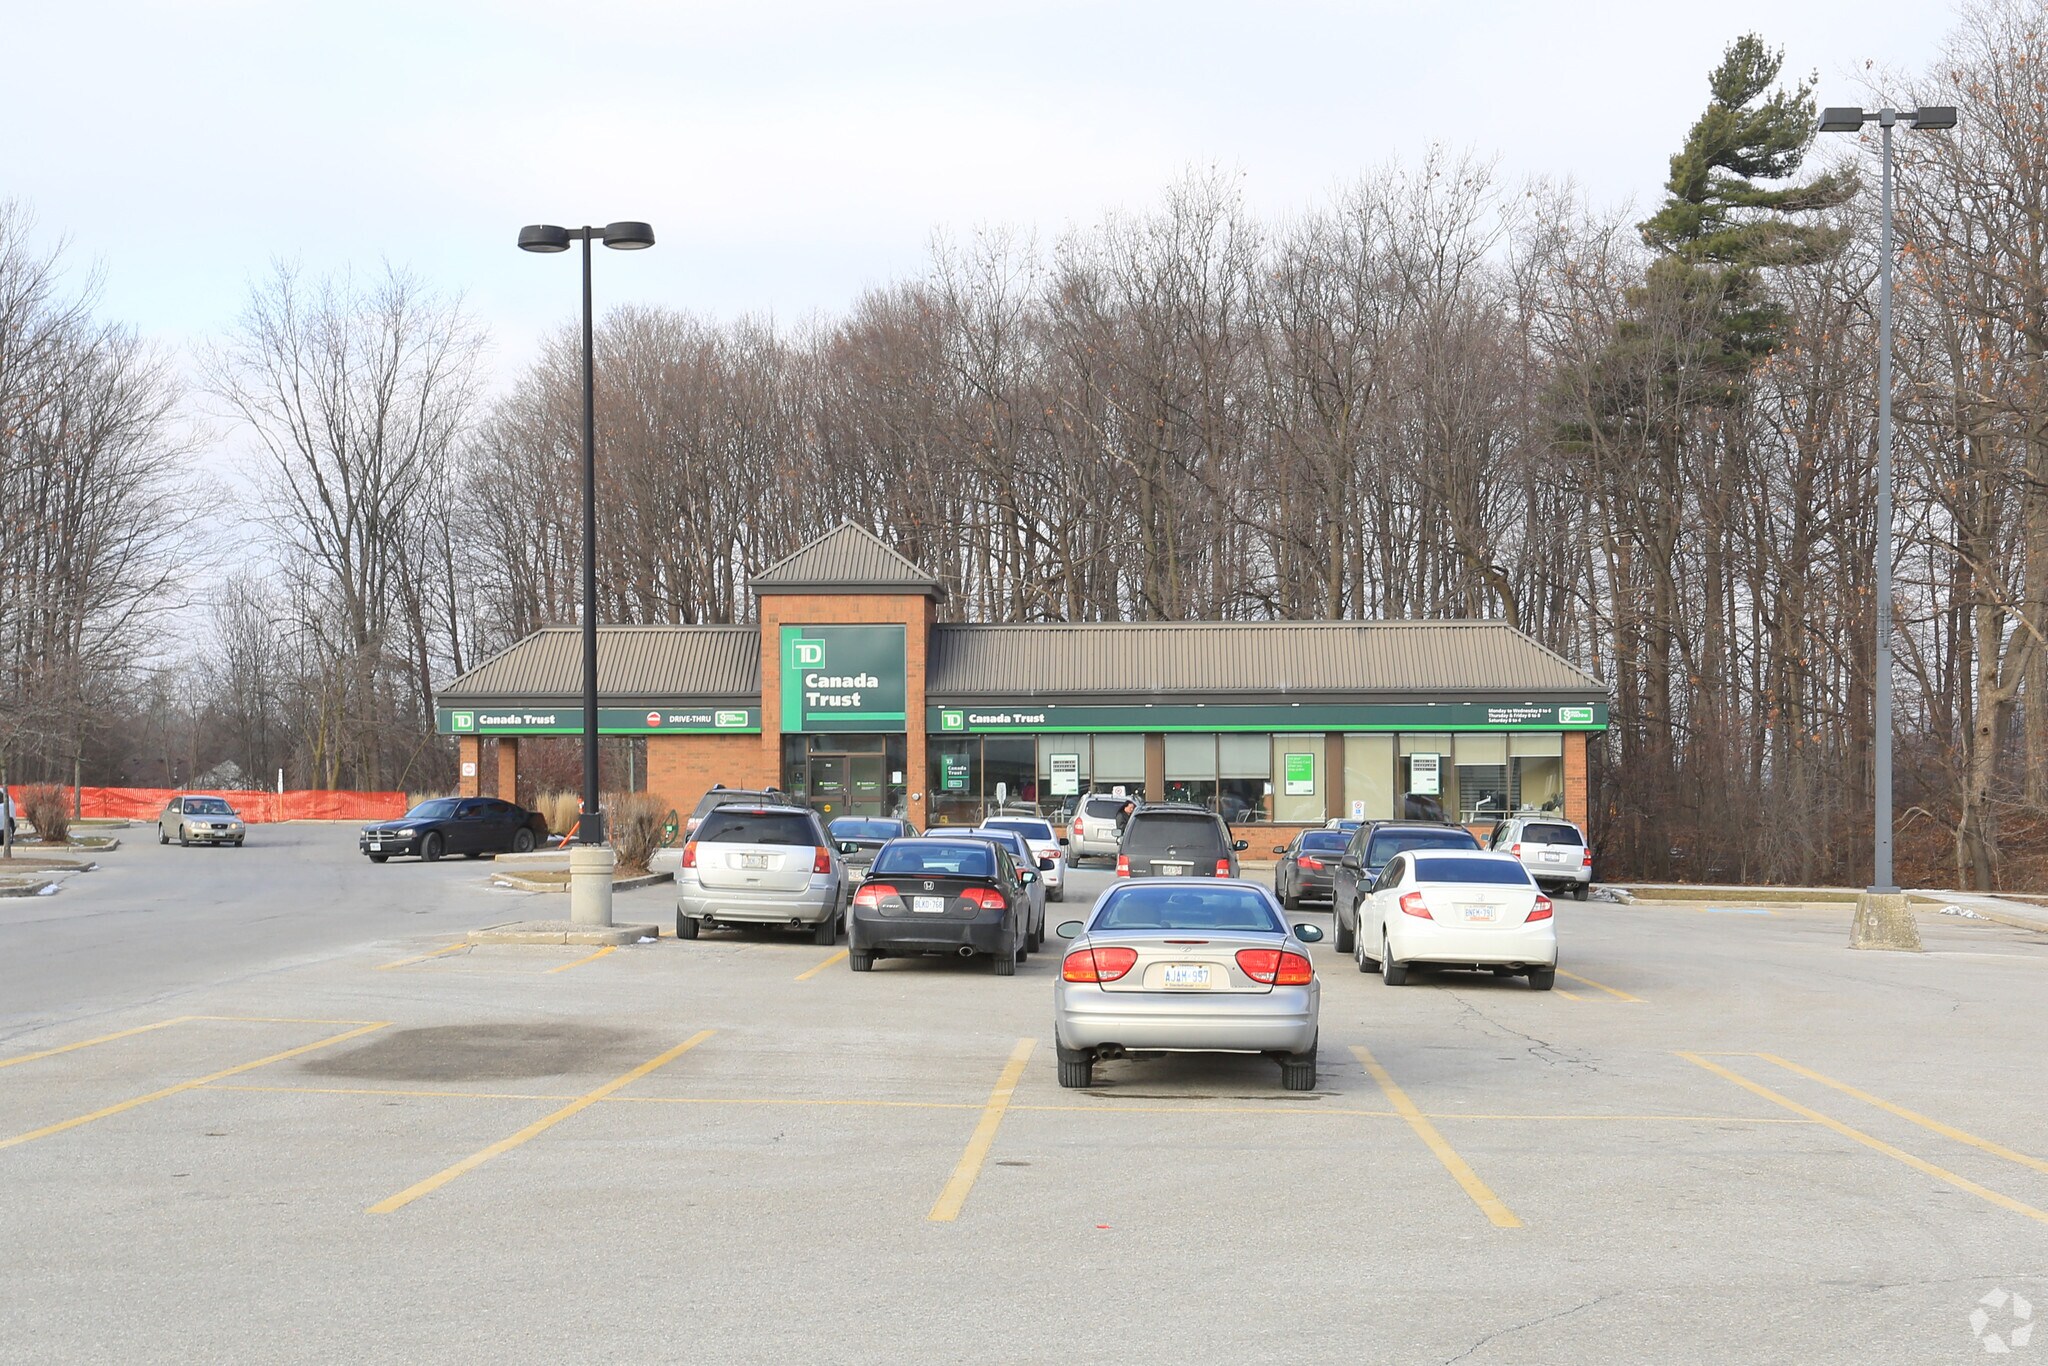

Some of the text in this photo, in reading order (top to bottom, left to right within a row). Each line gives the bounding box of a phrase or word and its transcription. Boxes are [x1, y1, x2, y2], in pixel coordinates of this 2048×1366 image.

[795, 645, 822, 663] TD
[805, 672, 879, 688] Canada
[806, 692, 861, 707] Trust
[454, 714, 555, 728] TD Canada Trust
[669, 715, 711, 723] DRIVE-THRU
[944, 713, 1045, 727] TD Canada Trust
